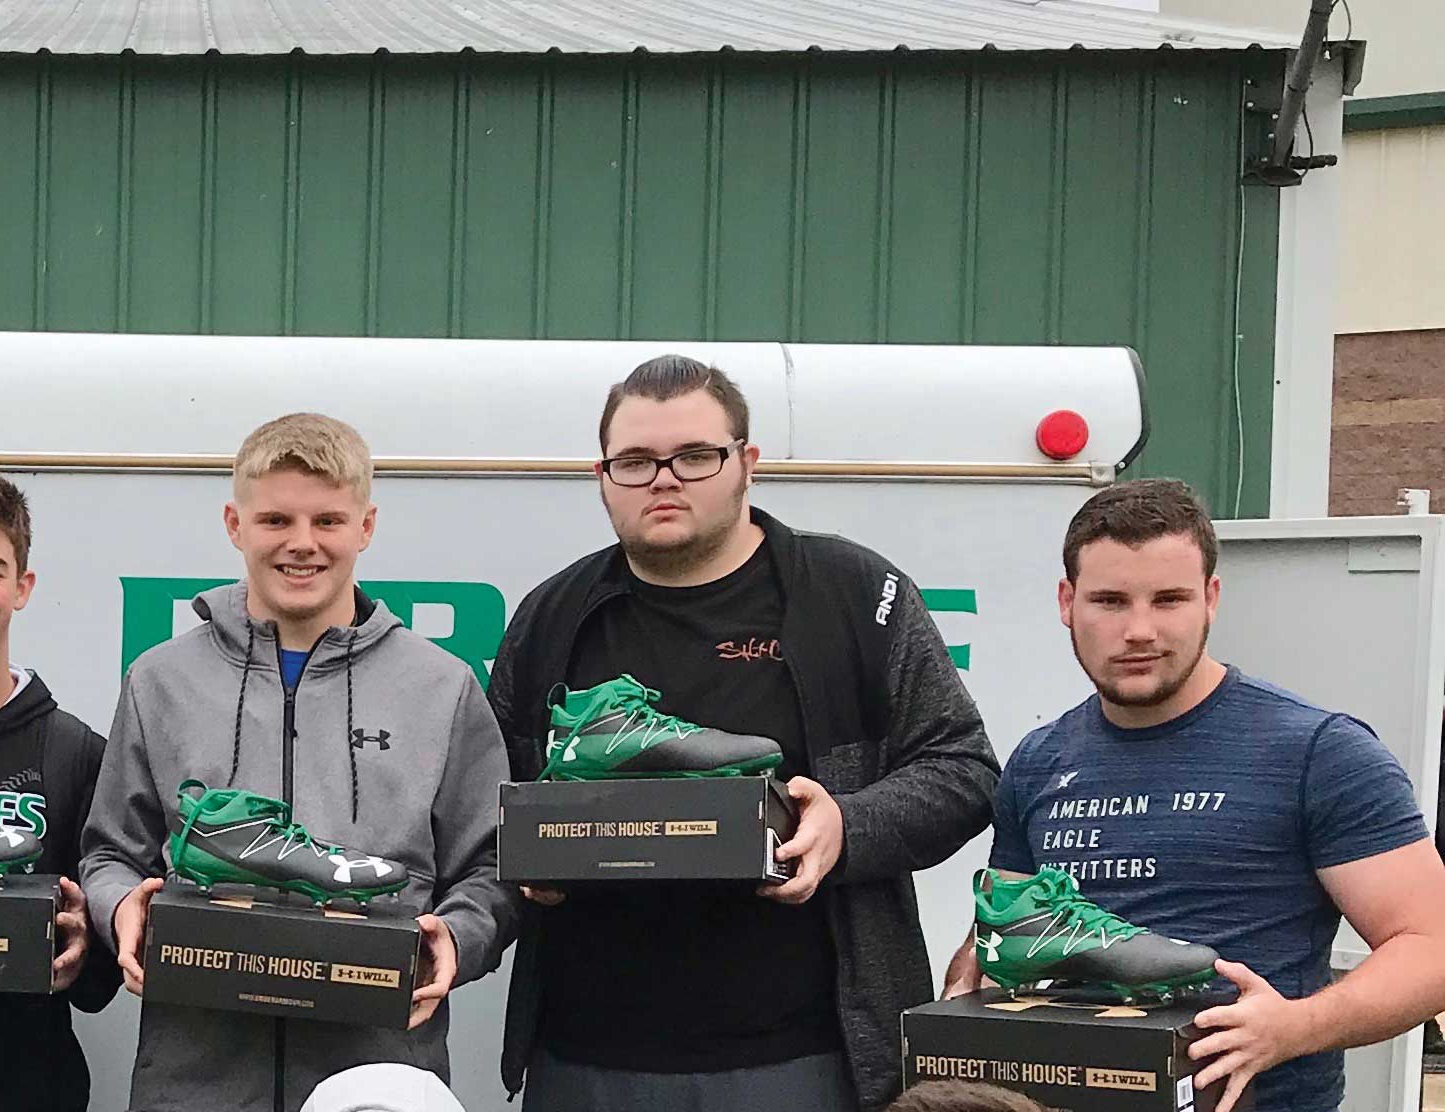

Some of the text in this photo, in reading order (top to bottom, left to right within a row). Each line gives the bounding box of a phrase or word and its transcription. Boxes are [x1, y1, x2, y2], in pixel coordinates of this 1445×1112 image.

[1048, 792, 1226, 819] AMERICAN 1977
[538, 823, 593, 838] PROTECT
[594, 823, 616, 837] THIS
[1043, 829, 1101, 850] EAGLE
[160, 945, 234, 970] PROTECT
[236, 952, 265, 974] THIS
[916, 1055, 987, 1080] PROTECT
[989, 1060, 1019, 1082] THIS
